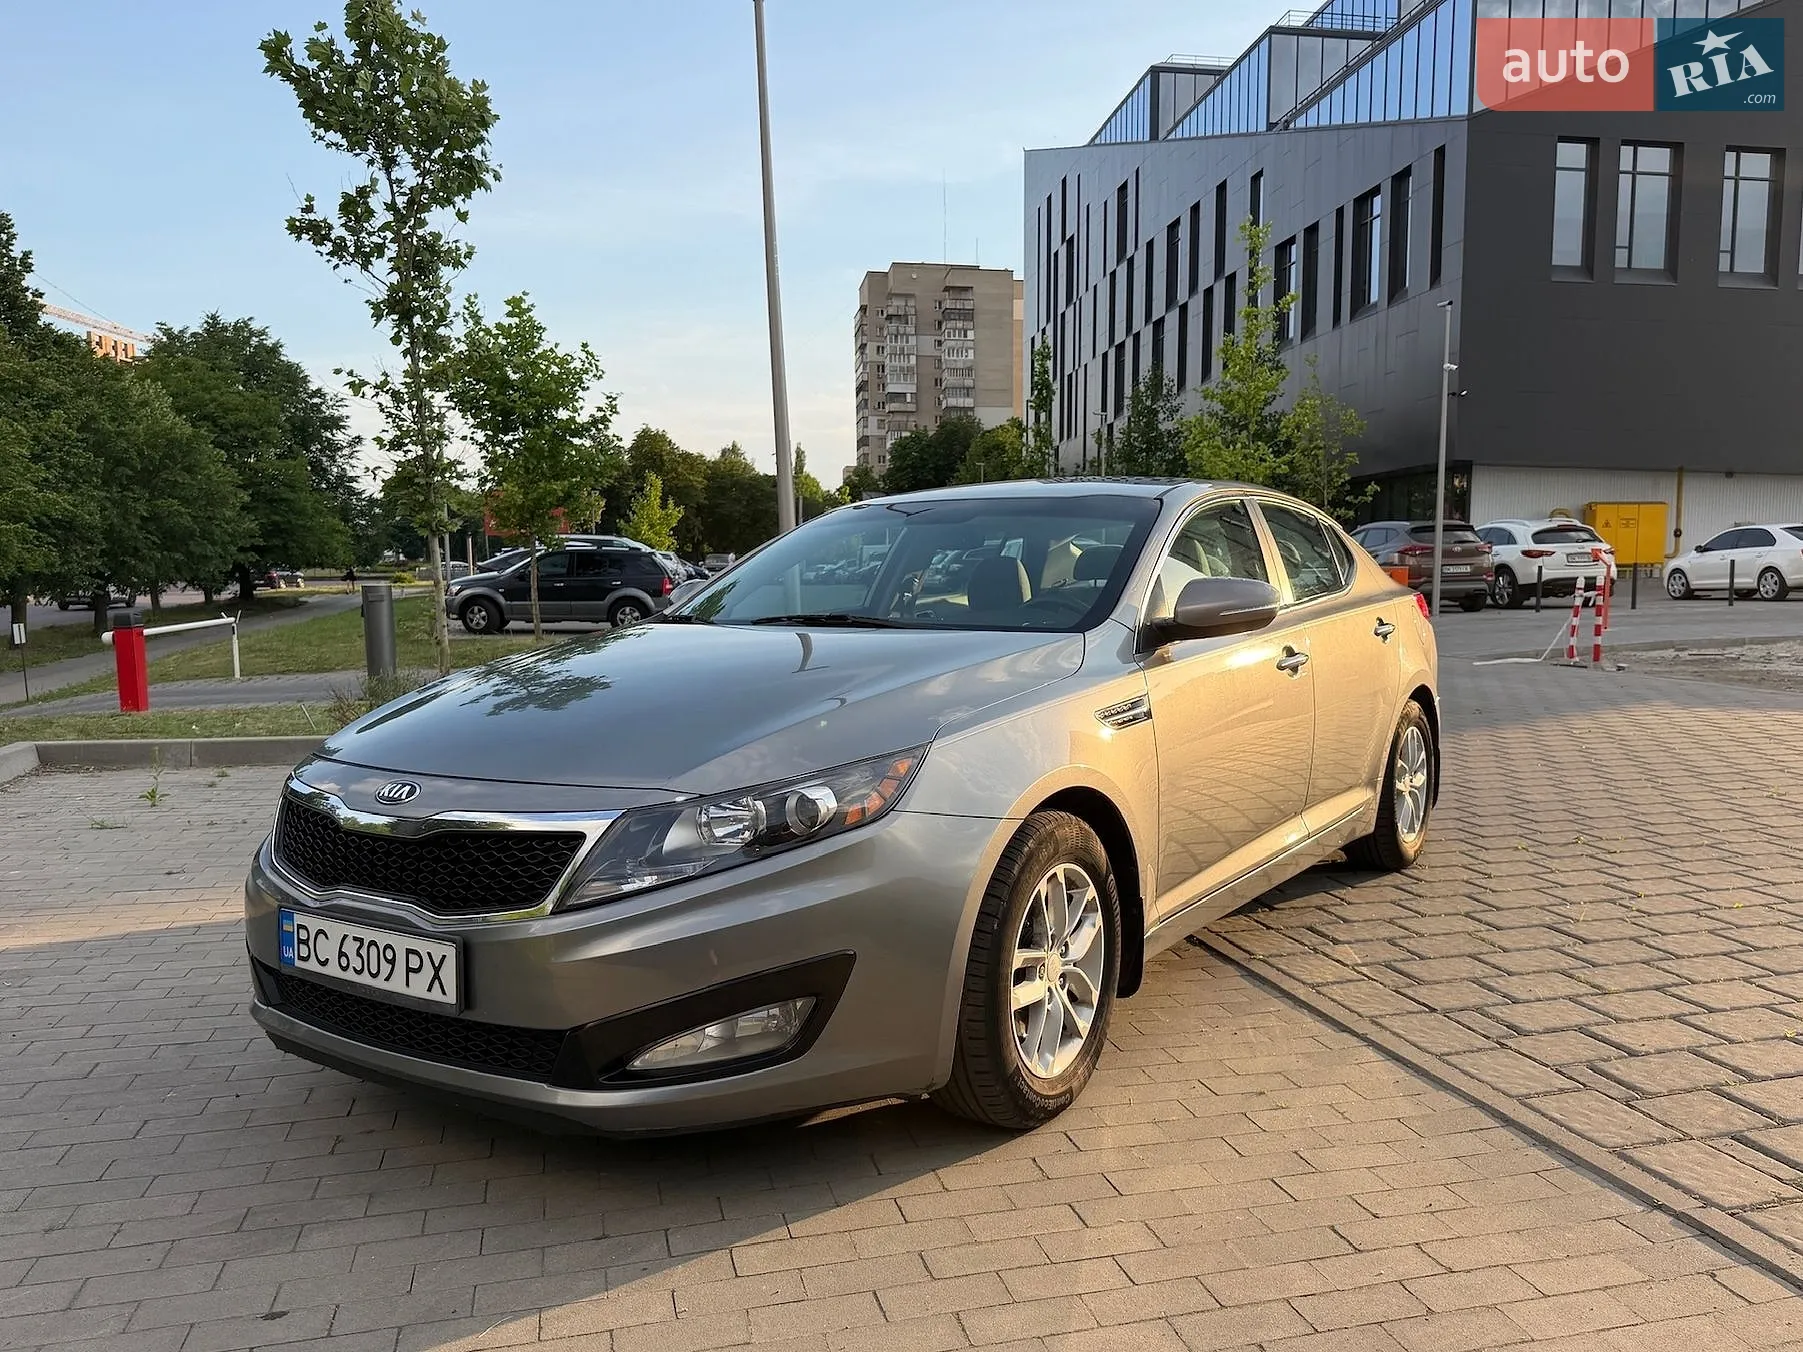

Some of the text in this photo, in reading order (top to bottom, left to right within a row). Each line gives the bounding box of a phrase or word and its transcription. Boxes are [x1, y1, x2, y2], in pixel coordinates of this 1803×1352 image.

[379, 783, 412, 799] KIA
[283, 945, 294, 959] UA
[296, 923, 447, 996] BC 6309 PX
